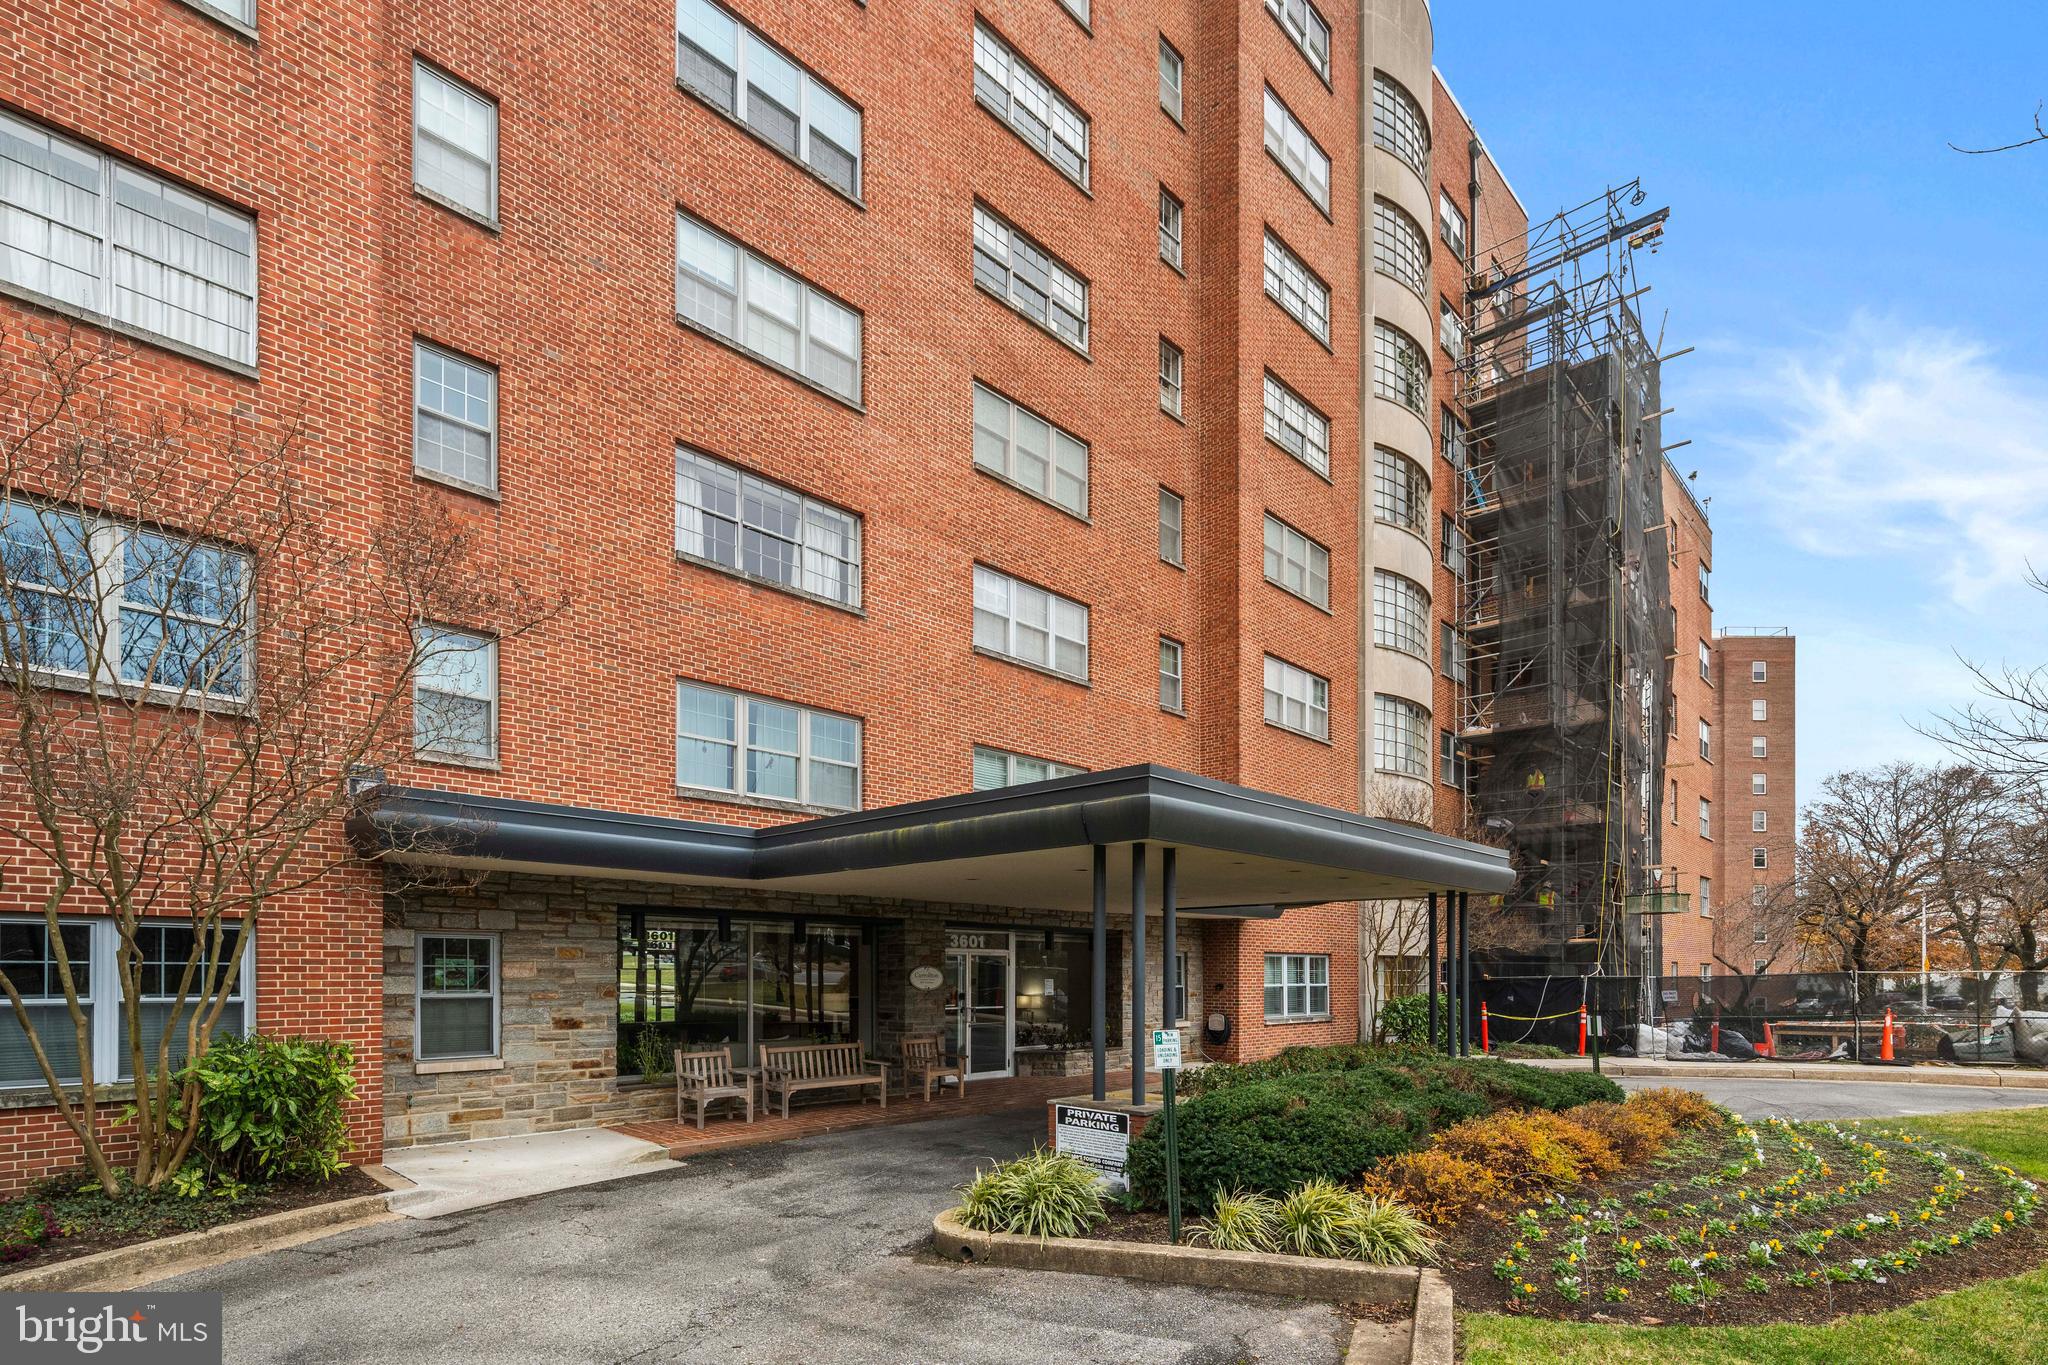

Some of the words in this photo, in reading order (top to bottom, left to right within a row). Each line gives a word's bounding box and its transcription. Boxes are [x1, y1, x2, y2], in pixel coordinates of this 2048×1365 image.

[950, 934, 985, 948] 3601
[1067, 1108, 1118, 1123] PRIVATE
[1065, 1117, 1120, 1132] PARKING
